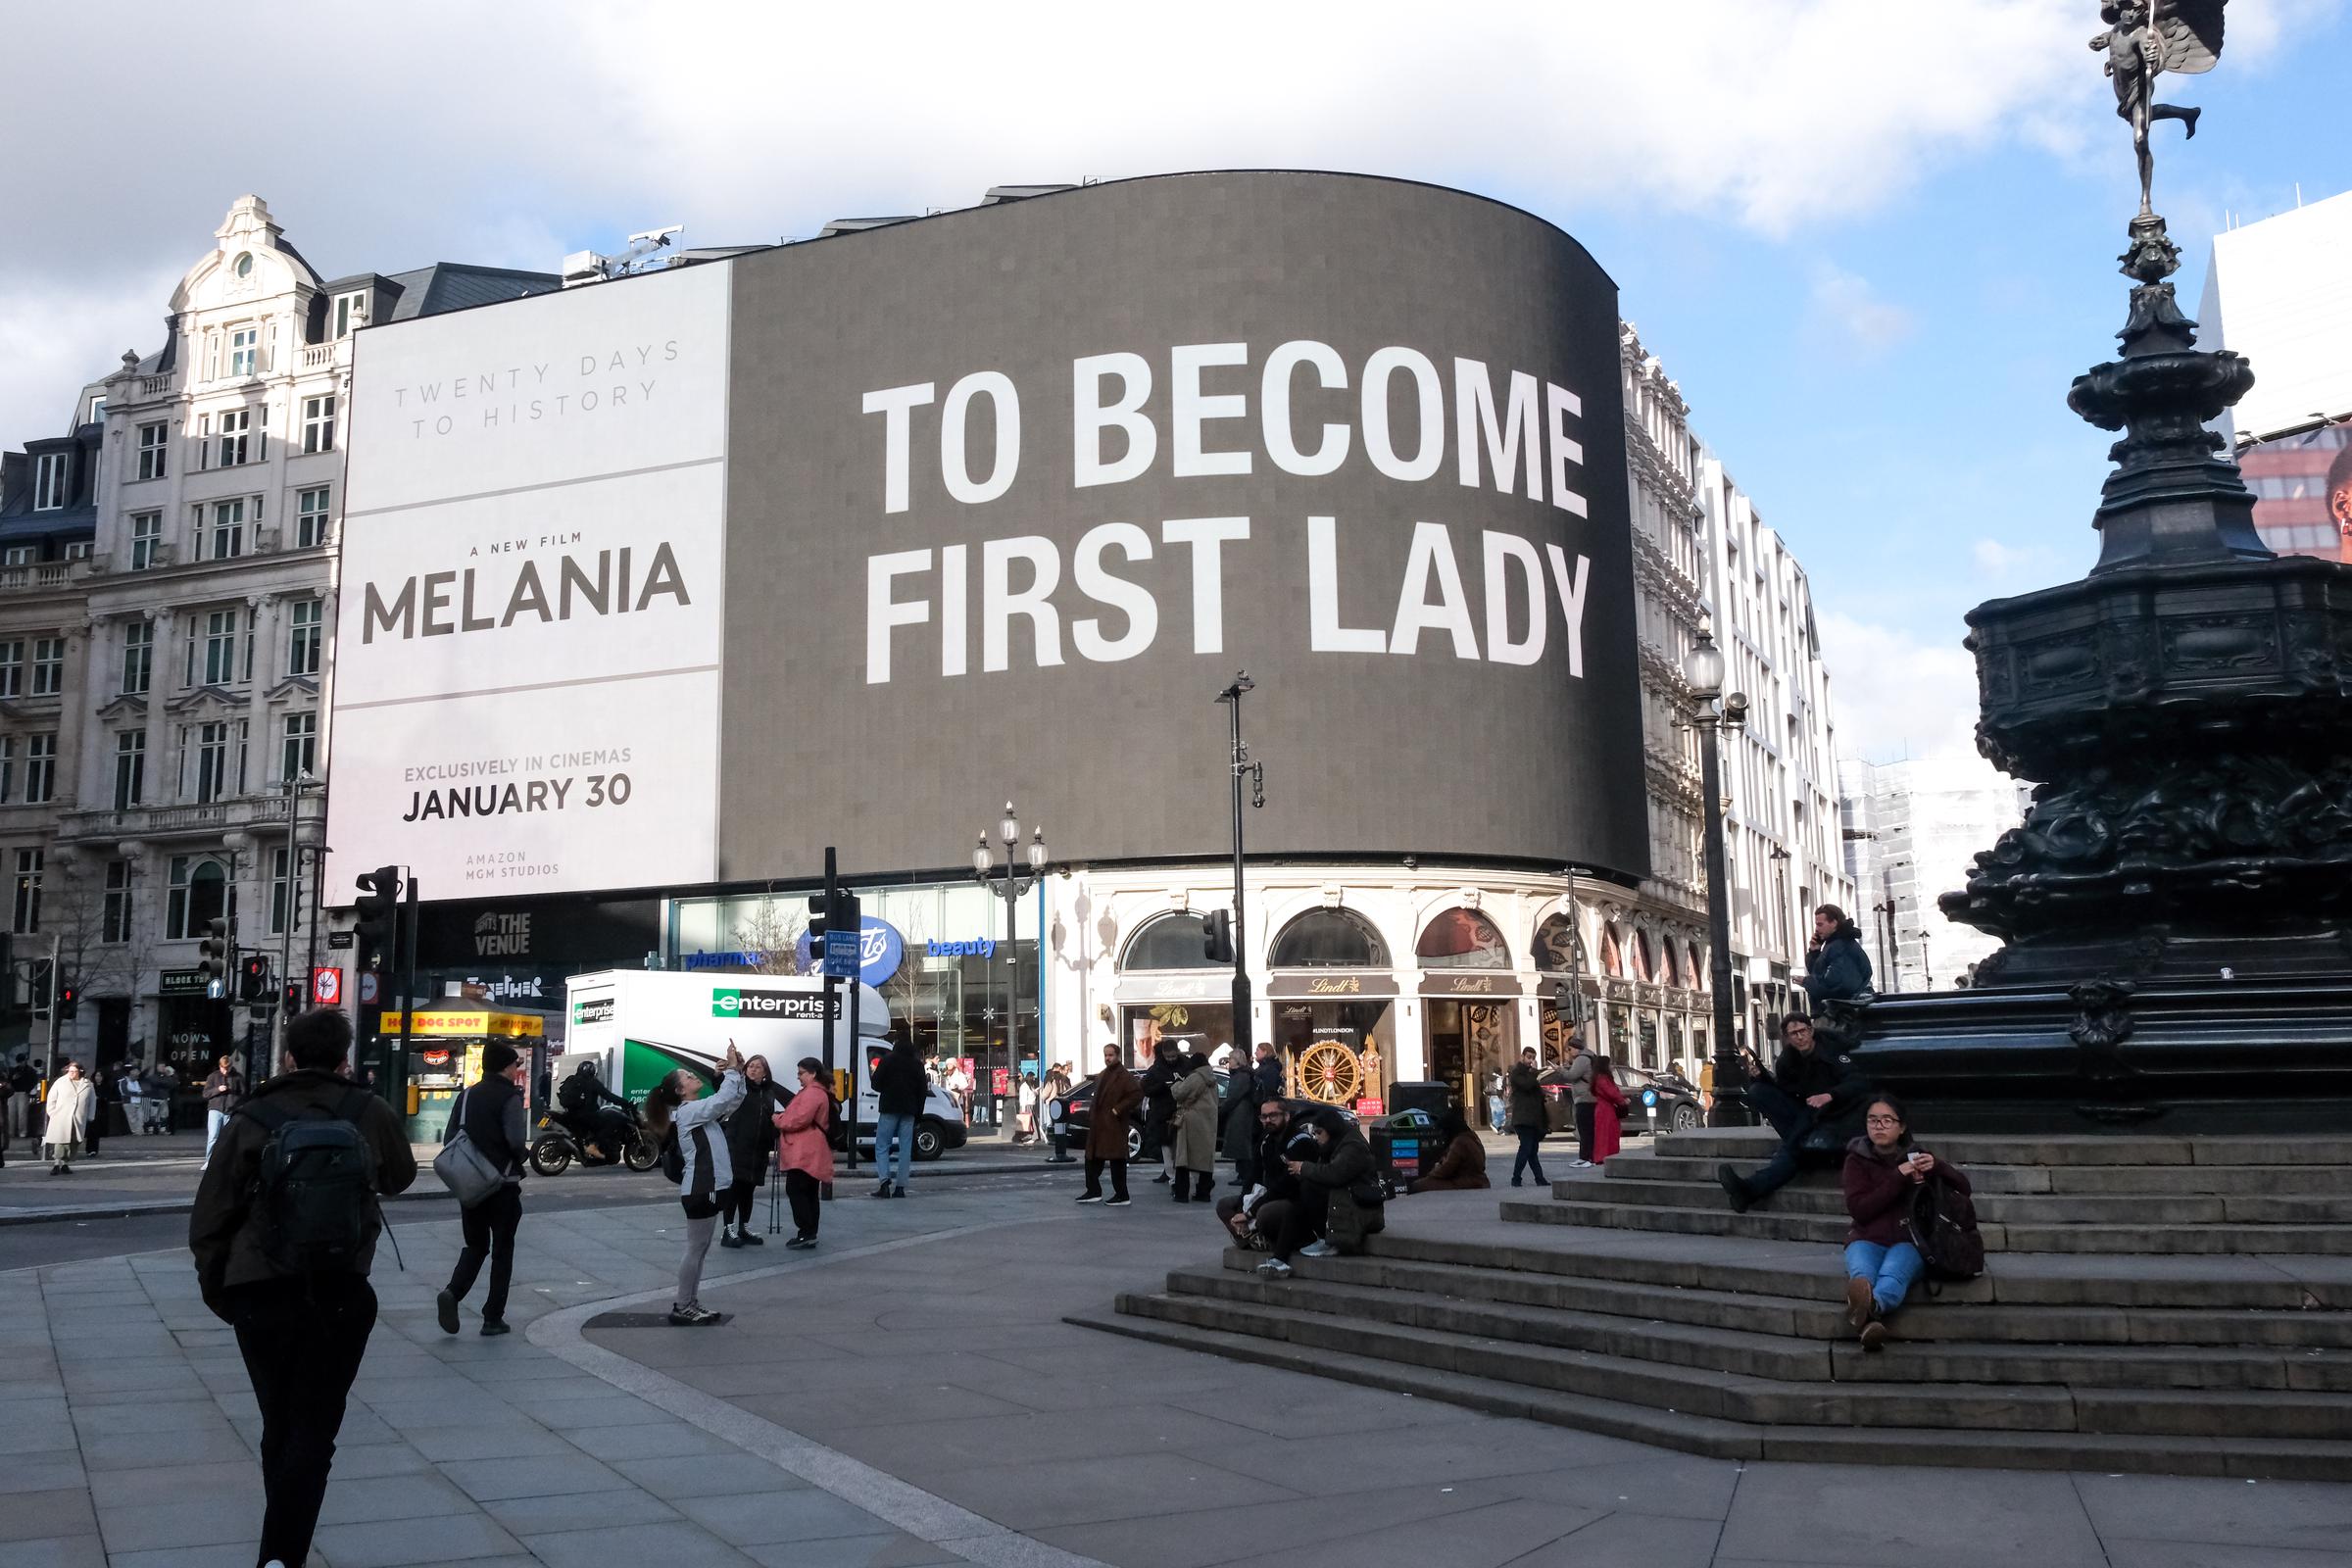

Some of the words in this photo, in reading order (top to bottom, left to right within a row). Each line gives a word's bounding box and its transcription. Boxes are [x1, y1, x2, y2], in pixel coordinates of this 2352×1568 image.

[395, 364, 549, 408] TWENTY
[580, 340, 679, 376] DAYS
[413, 414, 453, 439] TO
[484, 379, 657, 428] HISTORY
[862, 370, 1020, 514] TO
[1073, 339, 1588, 519] BECOME
[470, 547, 478, 557] A
[491, 540, 527, 554] NEW
[540, 532, 582, 548] FILM
[362, 541, 691, 645] MELANIA
[866, 515, 1250, 684] FIRST
[1307, 515, 1591, 679] LADY
[405, 758, 518, 783] EXCLUSIVELY
[525, 756, 543, 772] IN
[550, 748, 632, 769] CINEMAS
[403, 777, 573, 822] JANUARY
[585, 773, 632, 808] 30
[466, 852, 526, 865] AMAZON
[466, 869, 495, 880] MGM
[502, 864, 560, 878] STUDIOS
[499, 912, 531, 934] THE
[474, 934, 530, 956] VENUE
[927, 936, 996, 958] beauty
[1307, 978, 1349, 993] Lindt
[1449, 977, 1484, 992] Lindt
[1284, 1004, 1307, 1013] Lindt
[417, 1018, 444, 1027] DOG
[448, 1018, 480, 1027] SPOT
[172, 1034, 200, 1044] NOW
[171, 1051, 209, 1060] OPEN
